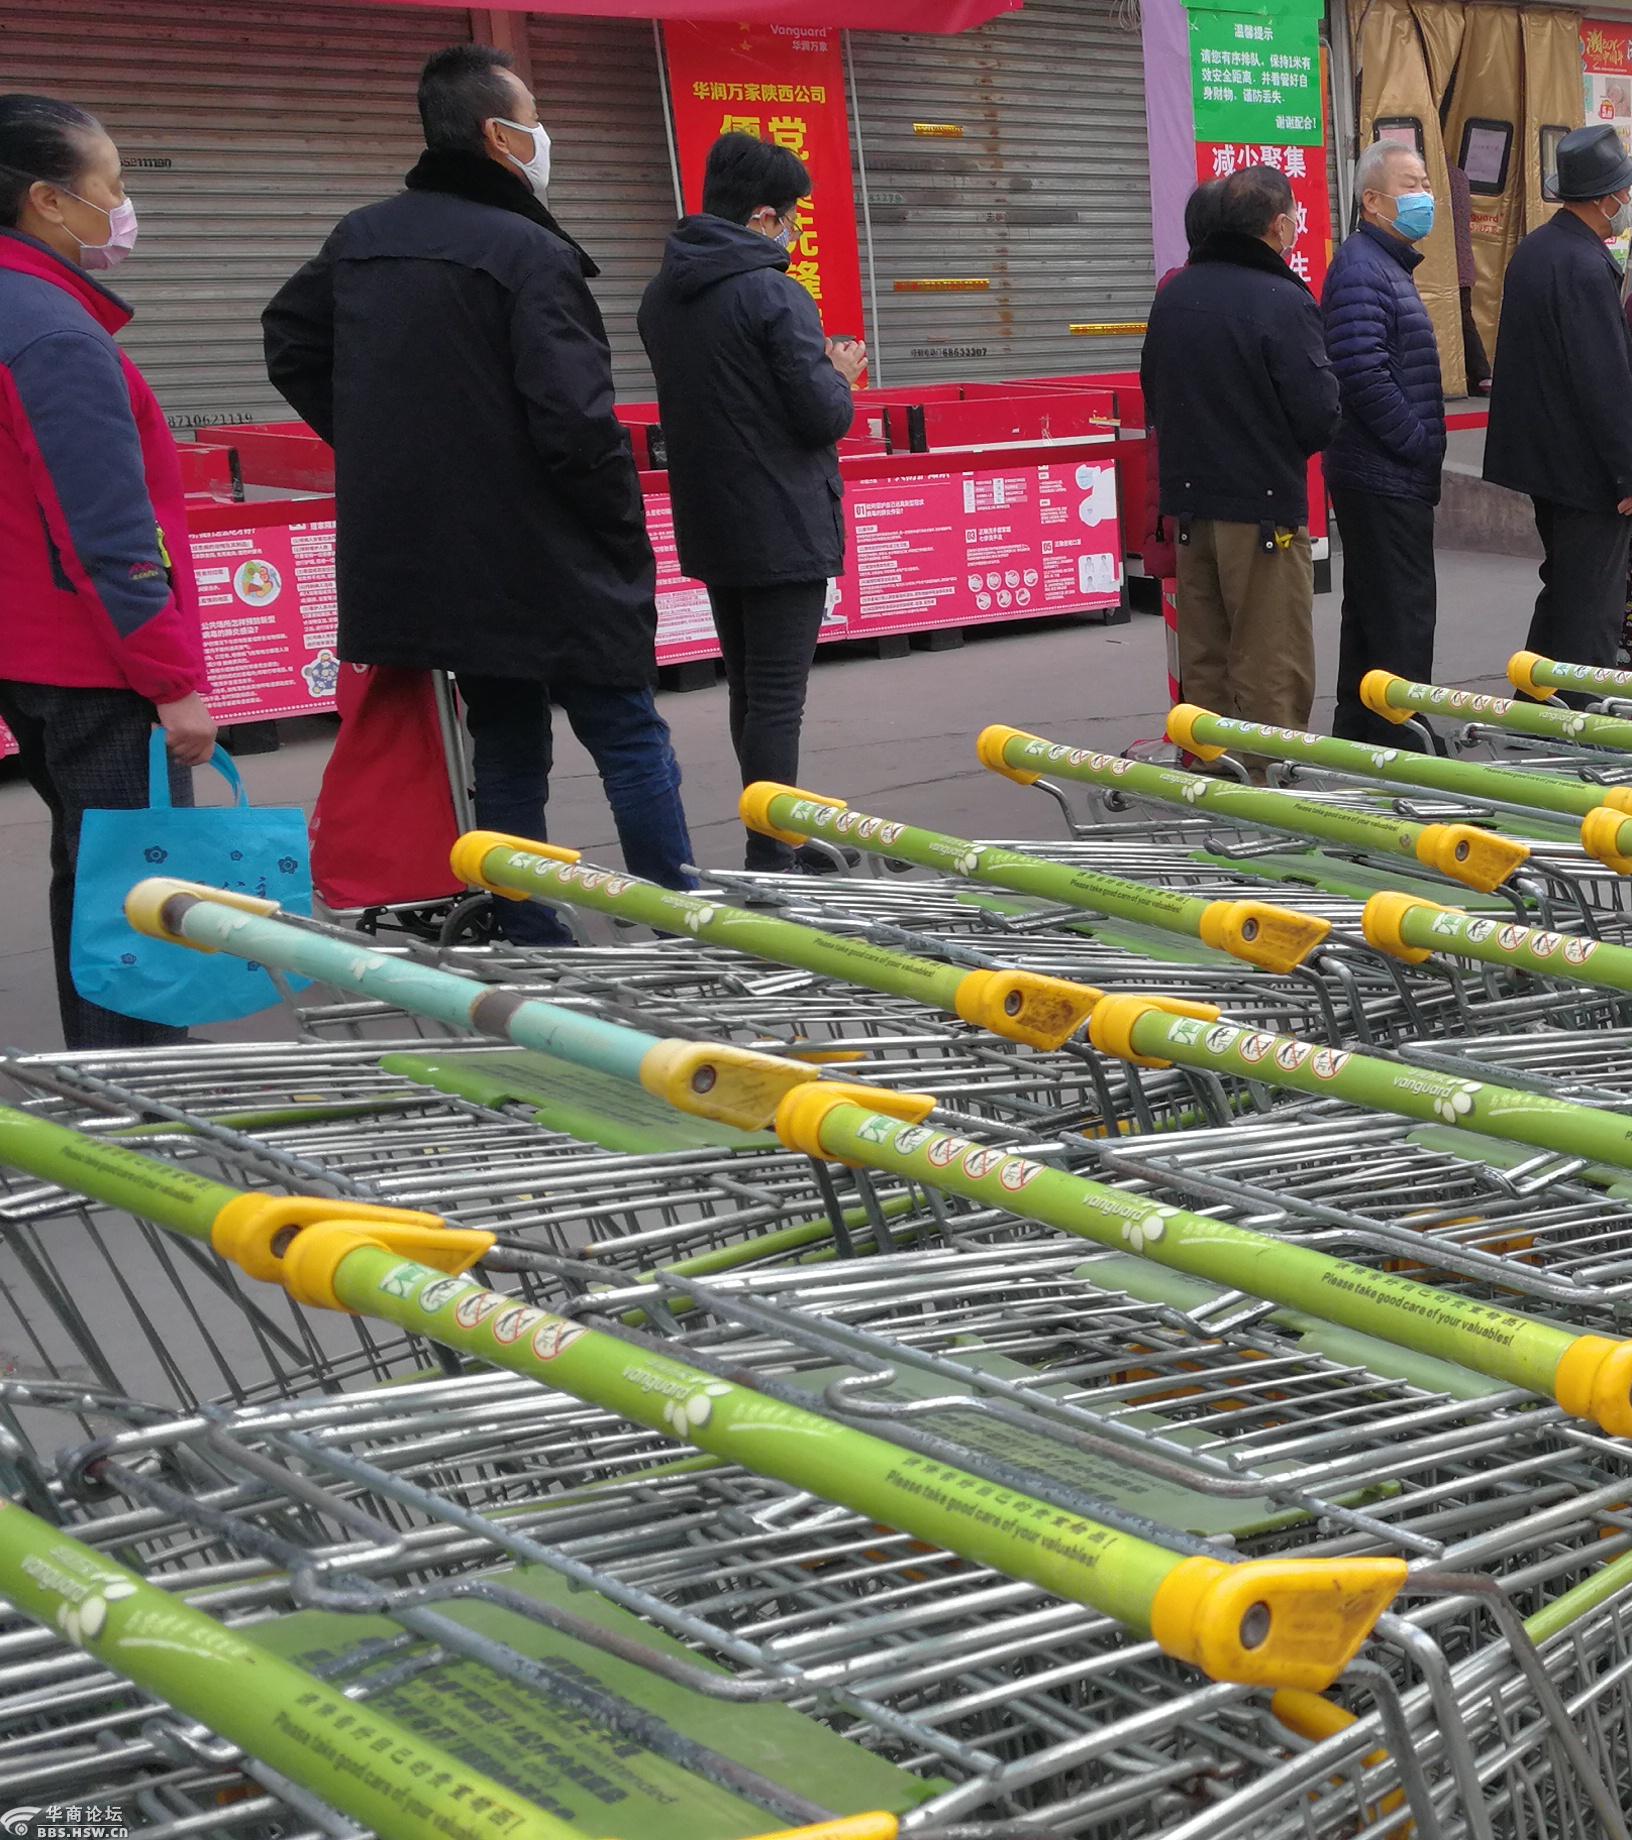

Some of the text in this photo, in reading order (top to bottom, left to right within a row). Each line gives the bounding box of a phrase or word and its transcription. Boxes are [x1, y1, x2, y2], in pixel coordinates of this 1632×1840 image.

[770, 24, 828, 39] Vanguard
[1234, 23, 1274, 40] 温馨提示
[792, 40, 828, 52] 华润万家
[692, 81, 826, 104] 华润万家陕西公司
[1393, 1077, 1454, 1098] vanguard
[1083, 1194, 1150, 1221] vanguard
[1321, 1271, 1515, 1346] Please take good care of your valuables!
[623, 1366, 693, 1400] vanguard
